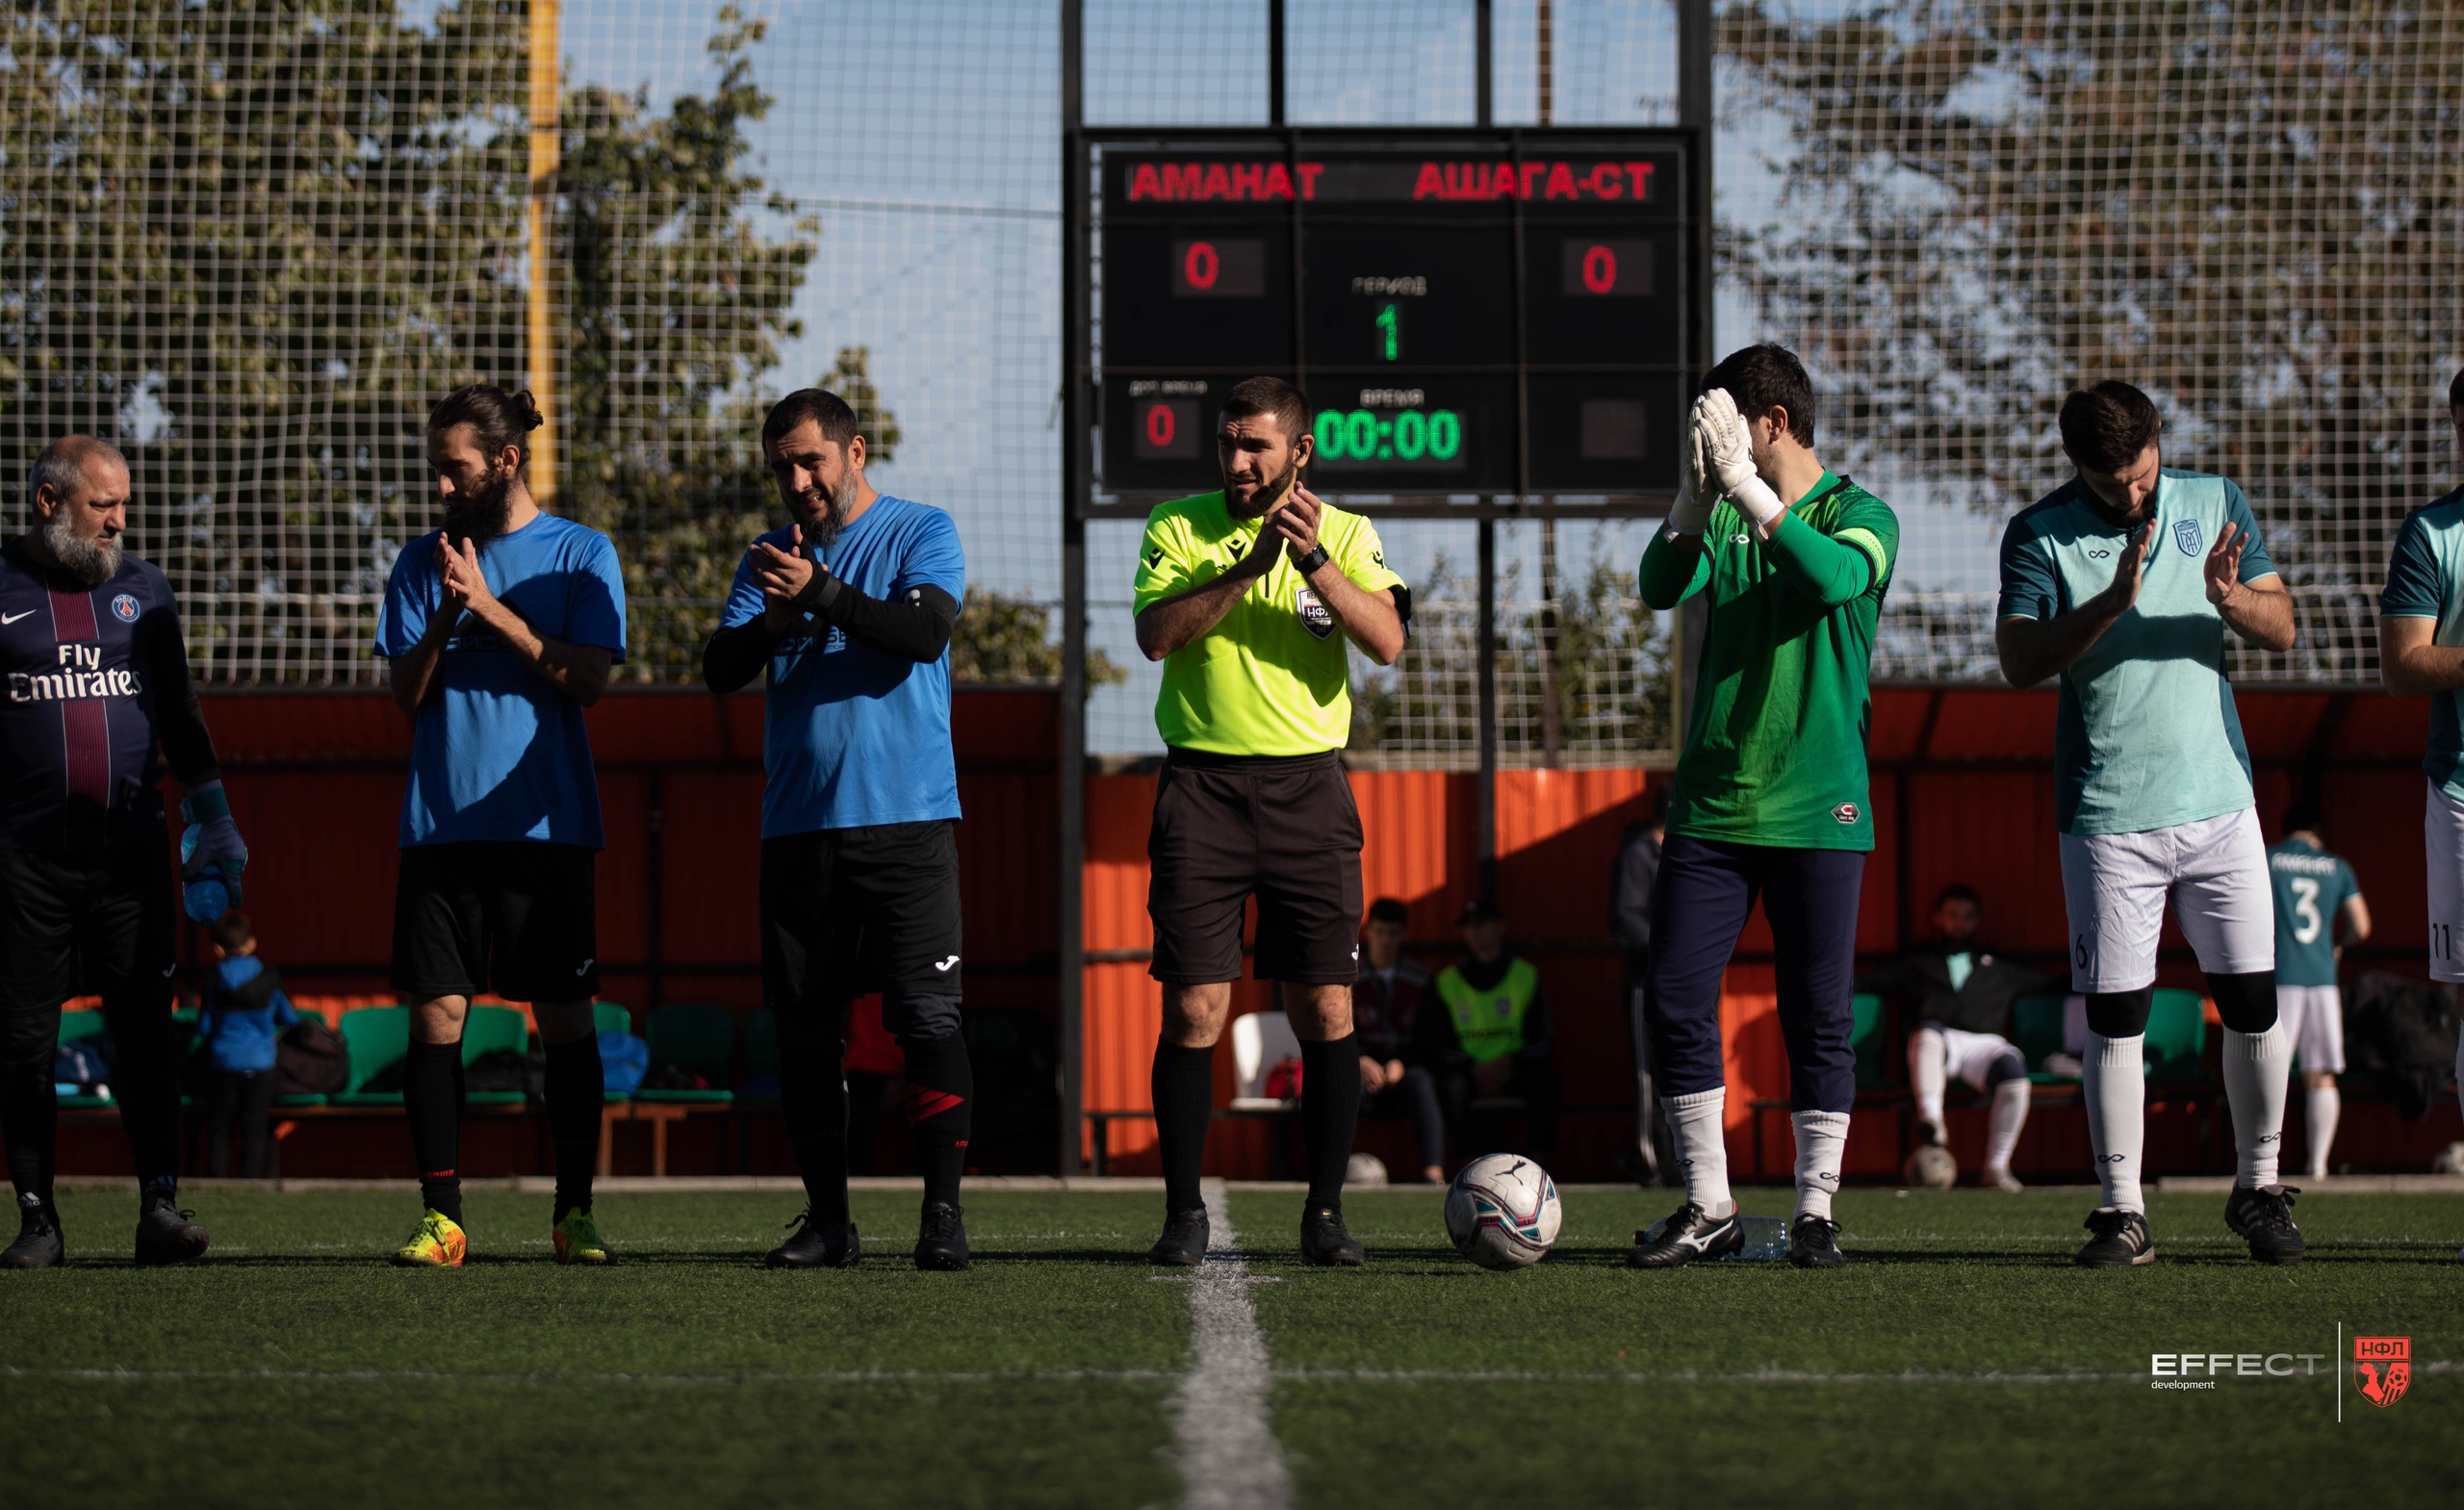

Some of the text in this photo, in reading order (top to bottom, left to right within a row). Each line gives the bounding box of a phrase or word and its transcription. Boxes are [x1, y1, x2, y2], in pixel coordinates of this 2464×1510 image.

[1131, 163, 1324, 201] АМАНАТ
[1412, 162, 1655, 200] АШАГА-СТ
[1185, 242, 1219, 289] 0
[1582, 245, 1617, 294] 0
[1375, 304, 1398, 361] 1
[1146, 404, 1175, 447] 0
[1313, 408, 1462, 461] 00:00
[1307, 606, 1328, 618] НФ
[59, 644, 101, 670] Fly
[8, 667, 142, 703] Emirates
[2291, 877, 2322, 944] 3
[2075, 934, 2088, 970] 6
[2432, 923, 2451, 960] 11
